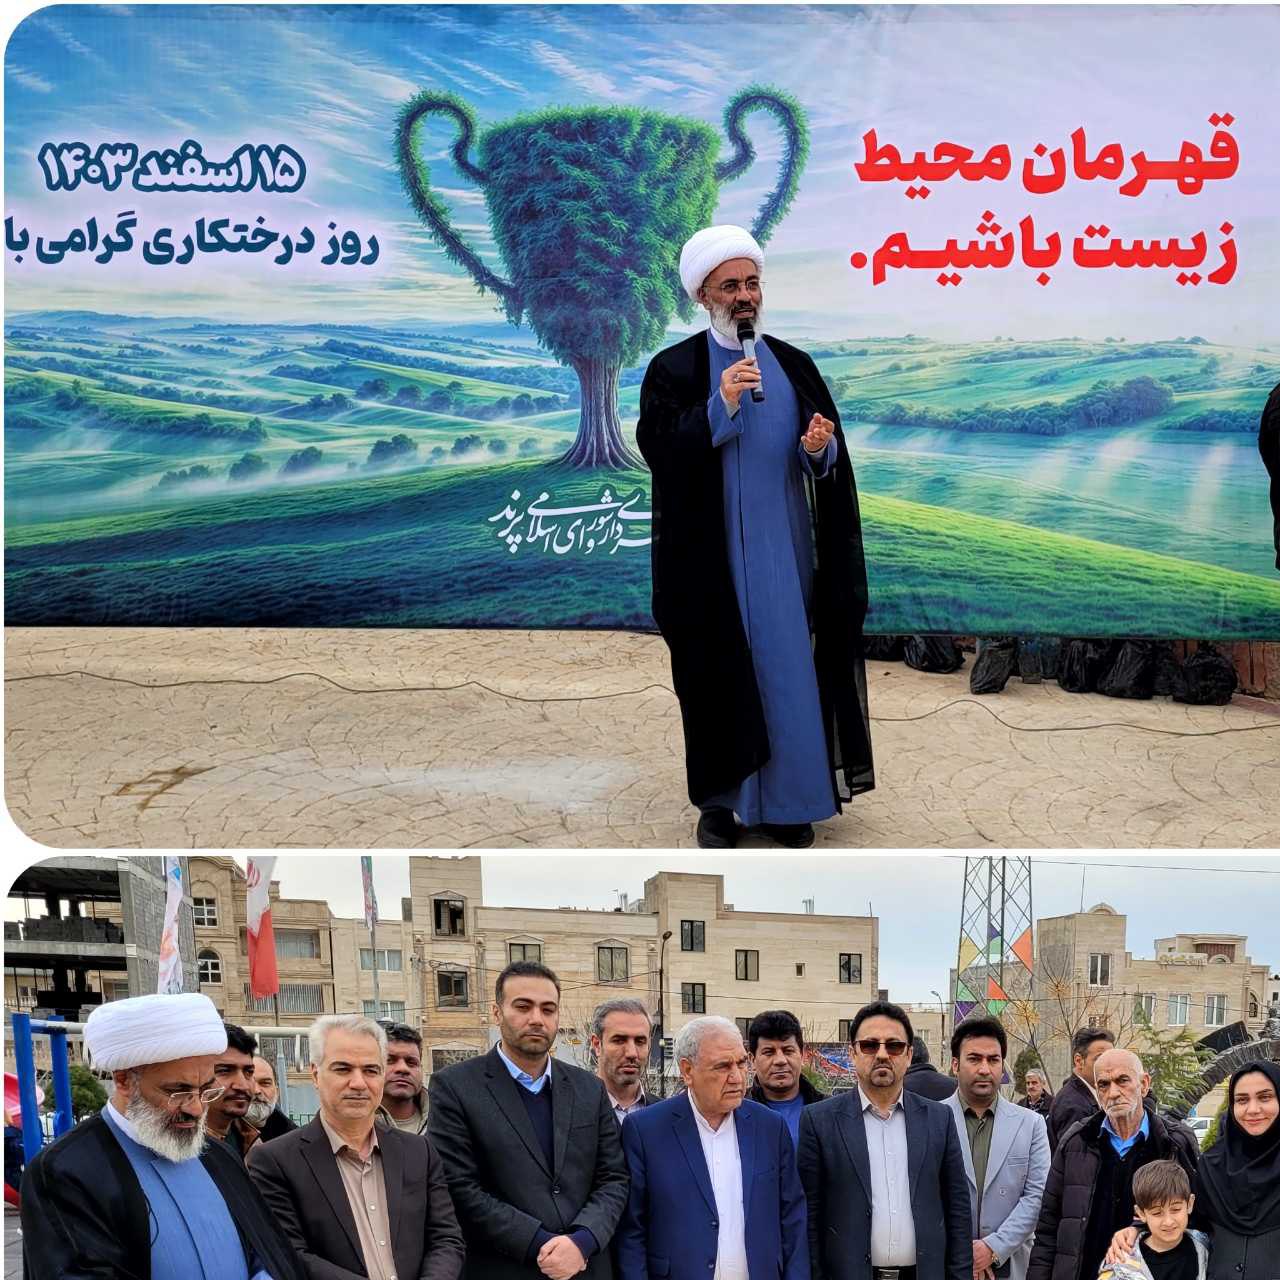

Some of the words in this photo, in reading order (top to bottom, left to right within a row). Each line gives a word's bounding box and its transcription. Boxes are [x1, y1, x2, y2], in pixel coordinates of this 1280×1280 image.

[38, 141, 138, 192] ۱۴۰۳
[133, 139, 257, 192] اسفند
[257, 143, 306, 192] ۱۵
[854, 128, 1012, 200] محیط
[1022, 112, 1240, 197] قهرمان
[36, 210, 138, 265] گرامی
[142, 215, 316, 265] درختکاری
[320, 221, 380, 265] روز
[850, 210, 1062, 286] باشیم.
[1072, 221, 1238, 286] زیست
[488, 489, 525, 554] پرند
